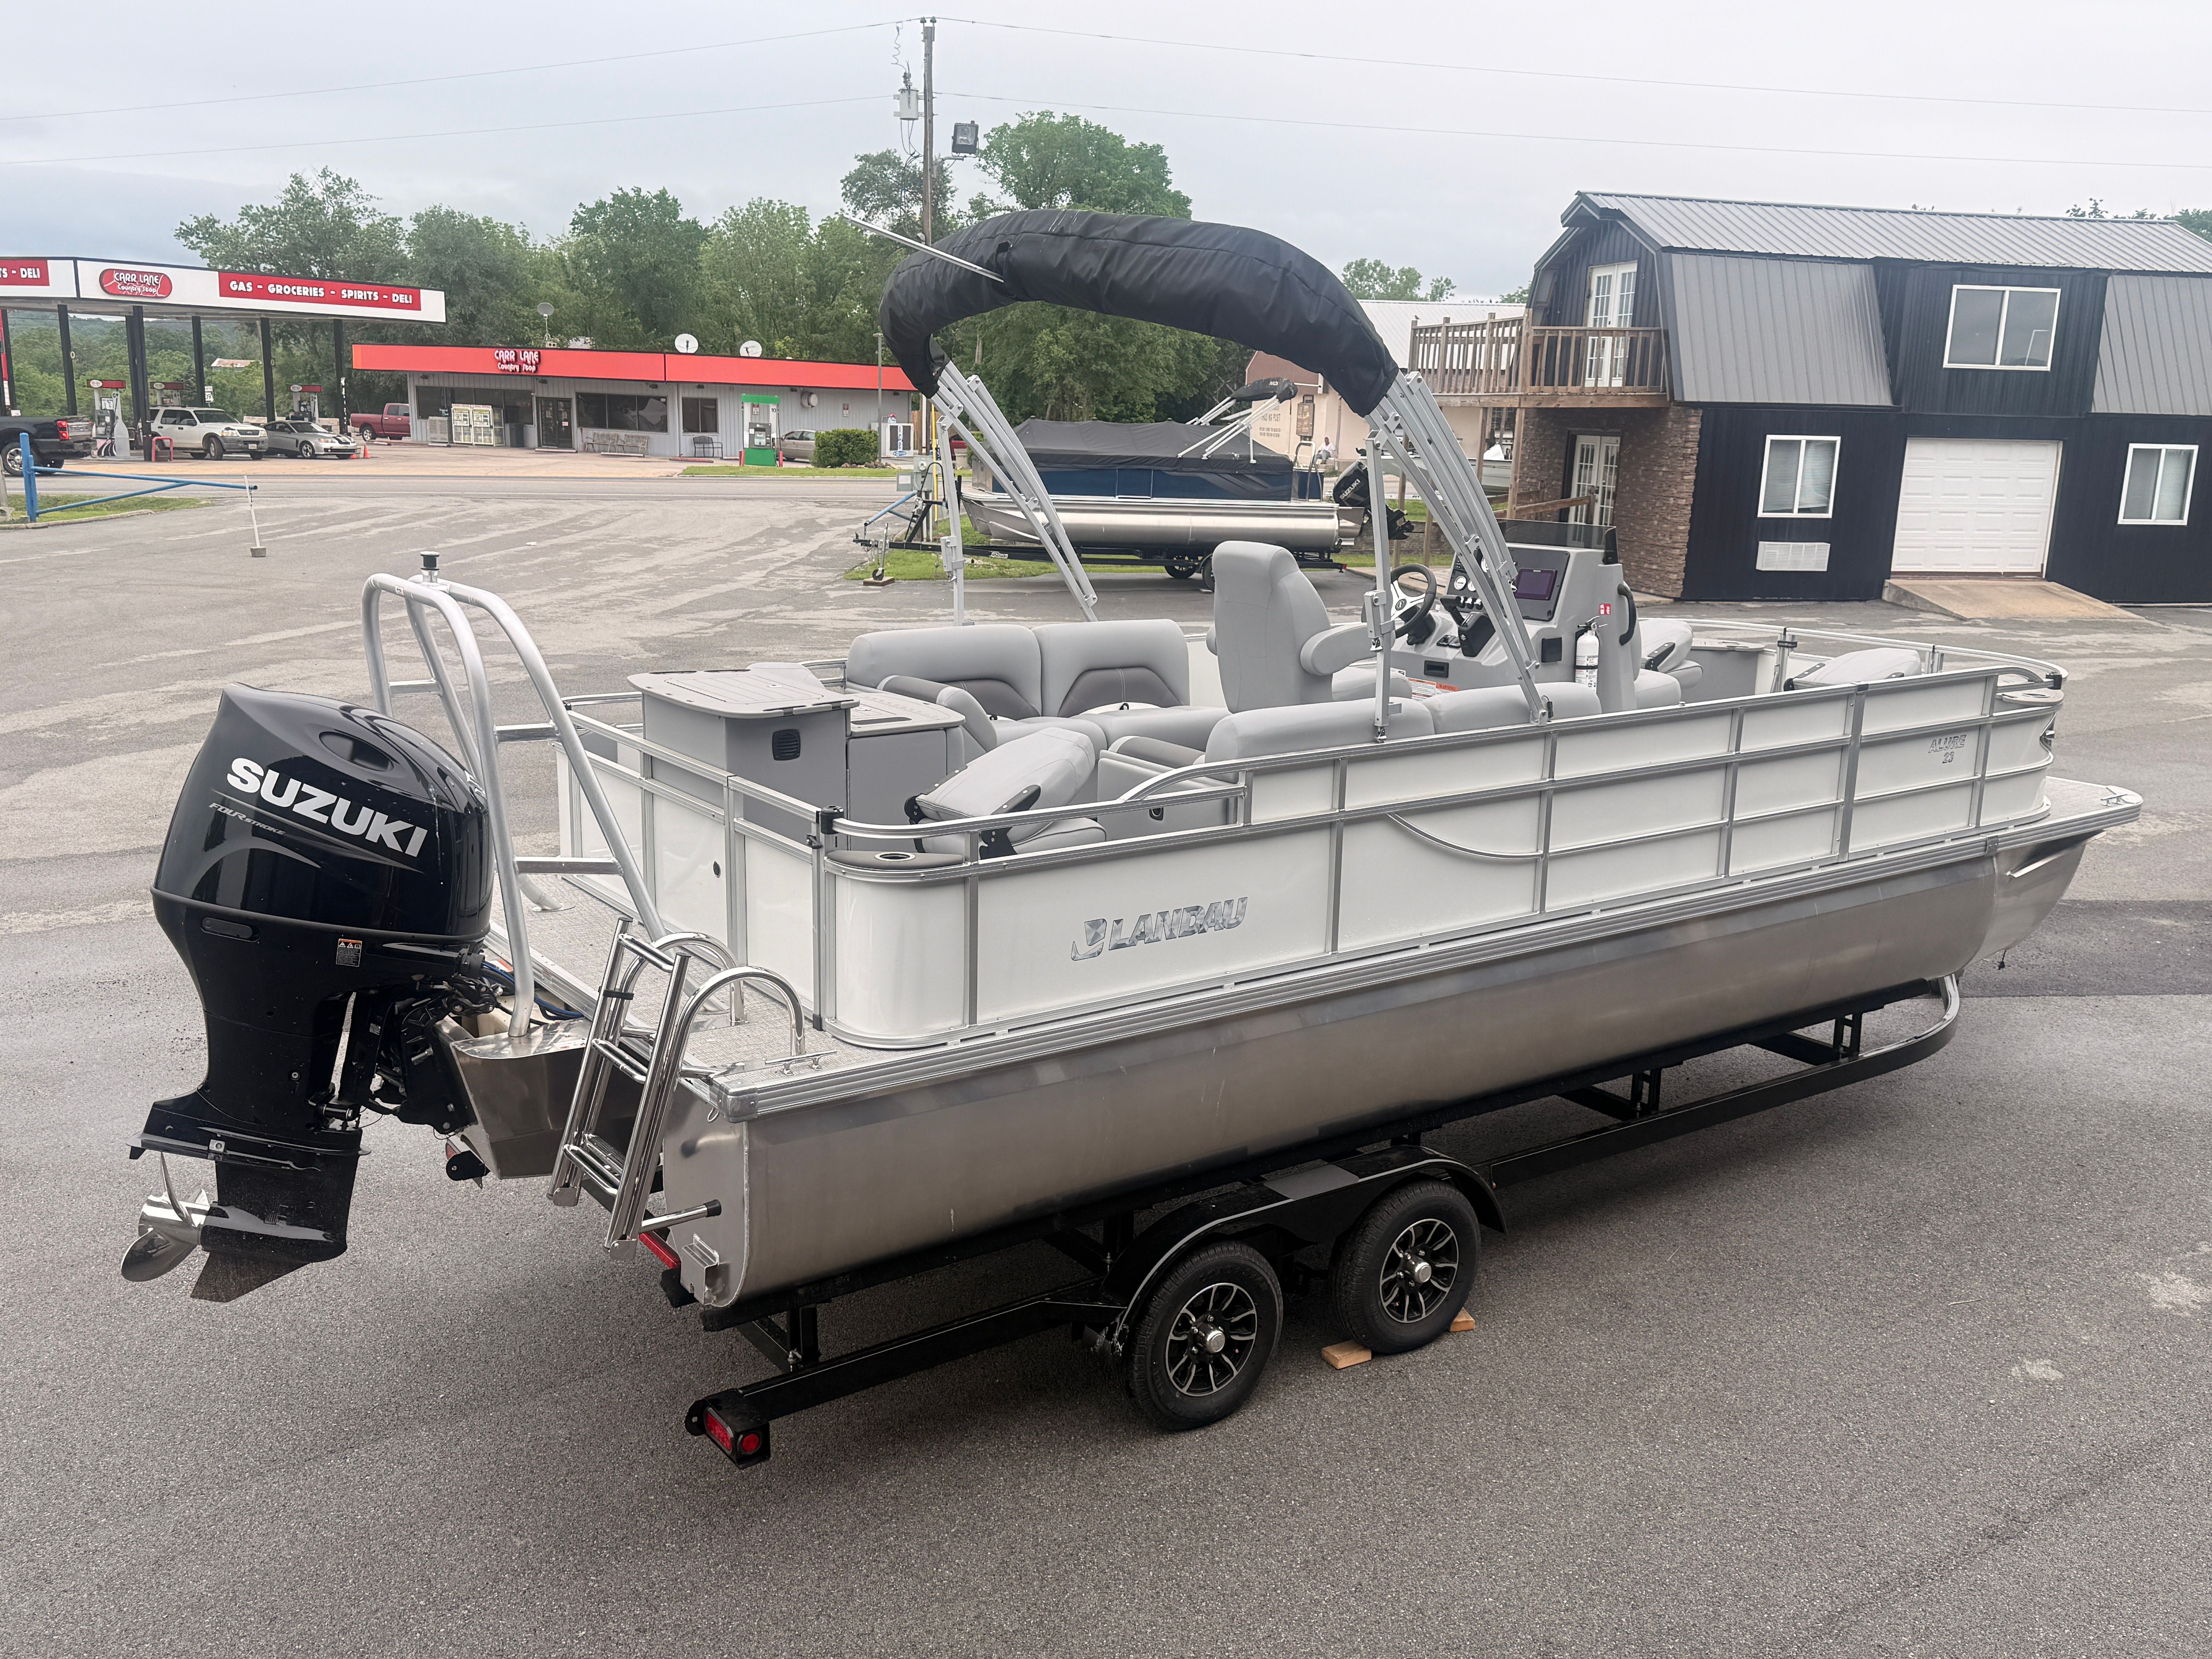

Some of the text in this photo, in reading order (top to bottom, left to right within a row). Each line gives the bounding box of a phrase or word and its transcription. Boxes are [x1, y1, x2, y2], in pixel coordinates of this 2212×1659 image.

[20, 268, 40, 278] DELI
[113, 272, 160, 286] CARR LANE
[117, 285, 143, 294] Country
[229, 280, 253, 292] GAS
[267, 283, 325, 297] GROCERIES
[341, 289, 379, 301] SPIRITS
[392, 293, 412, 304] DELI
[494, 350, 539, 365] CARR LANE
[498, 362, 536, 373] Country Stop
[1339, 478, 1361, 500] SUZUKI
[1928, 734, 1967, 754] ALURE
[227, 757, 428, 857] SUZUKI
[1109, 896, 1248, 951] LANDAU
